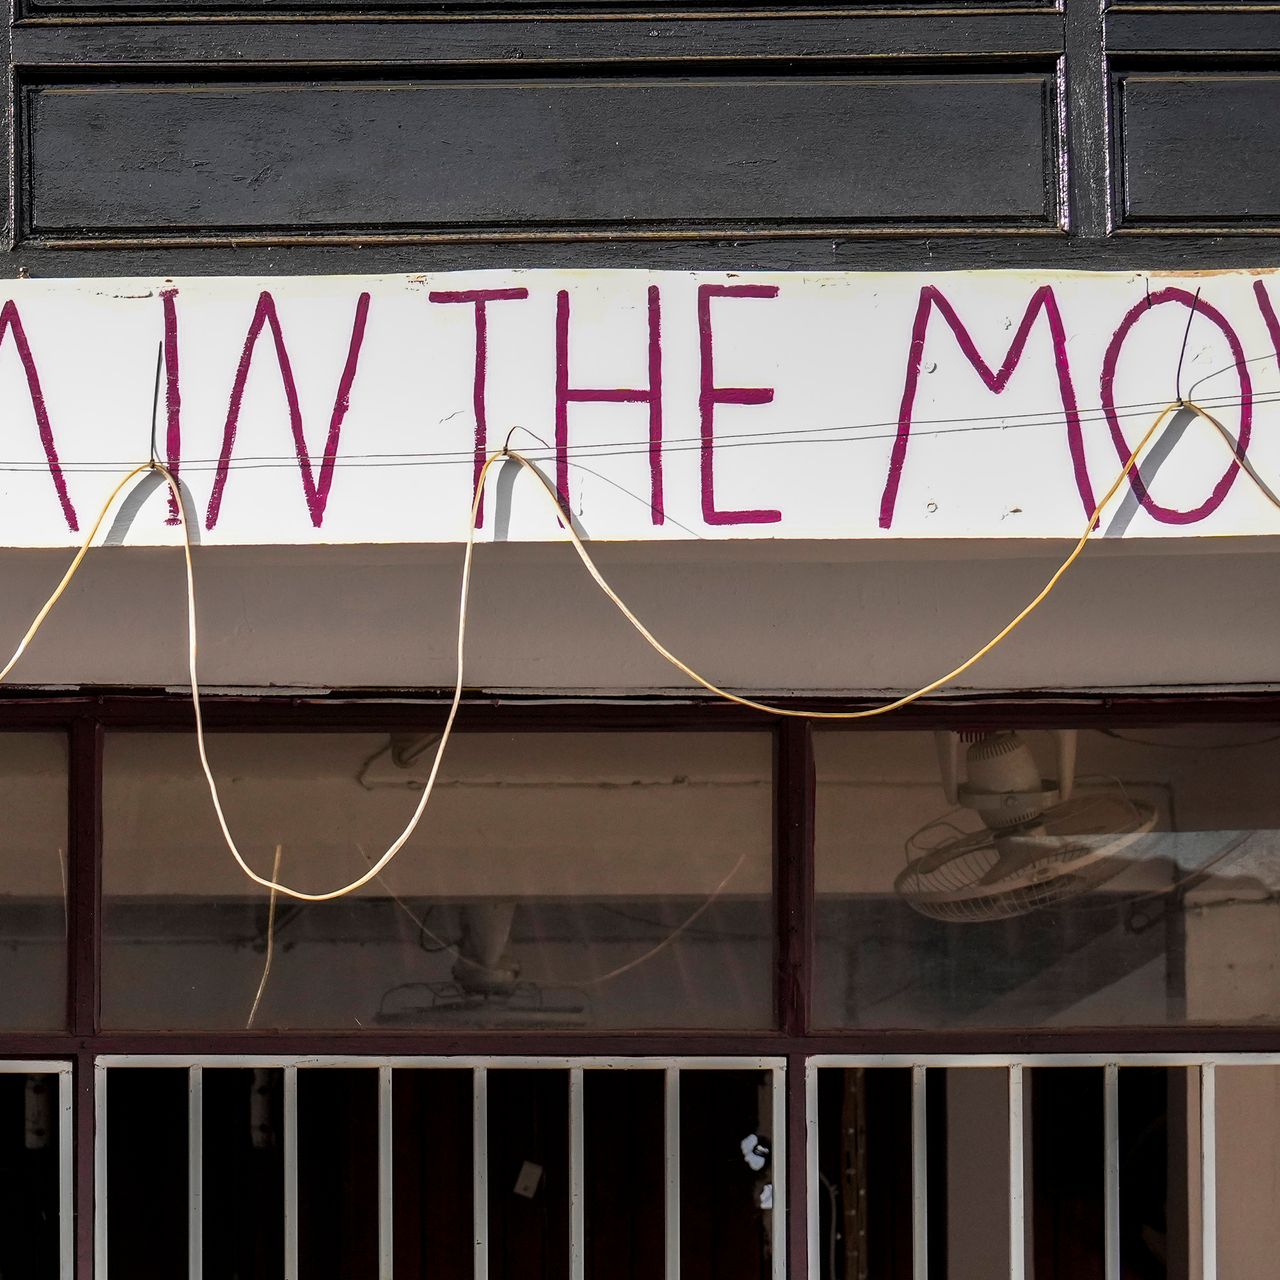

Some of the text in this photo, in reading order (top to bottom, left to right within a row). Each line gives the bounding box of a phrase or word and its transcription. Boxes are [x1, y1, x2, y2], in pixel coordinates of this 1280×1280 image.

[161, 286, 372, 532] IN
[428, 282, 783, 530] THE
[878, 277, 1280, 532] MO
